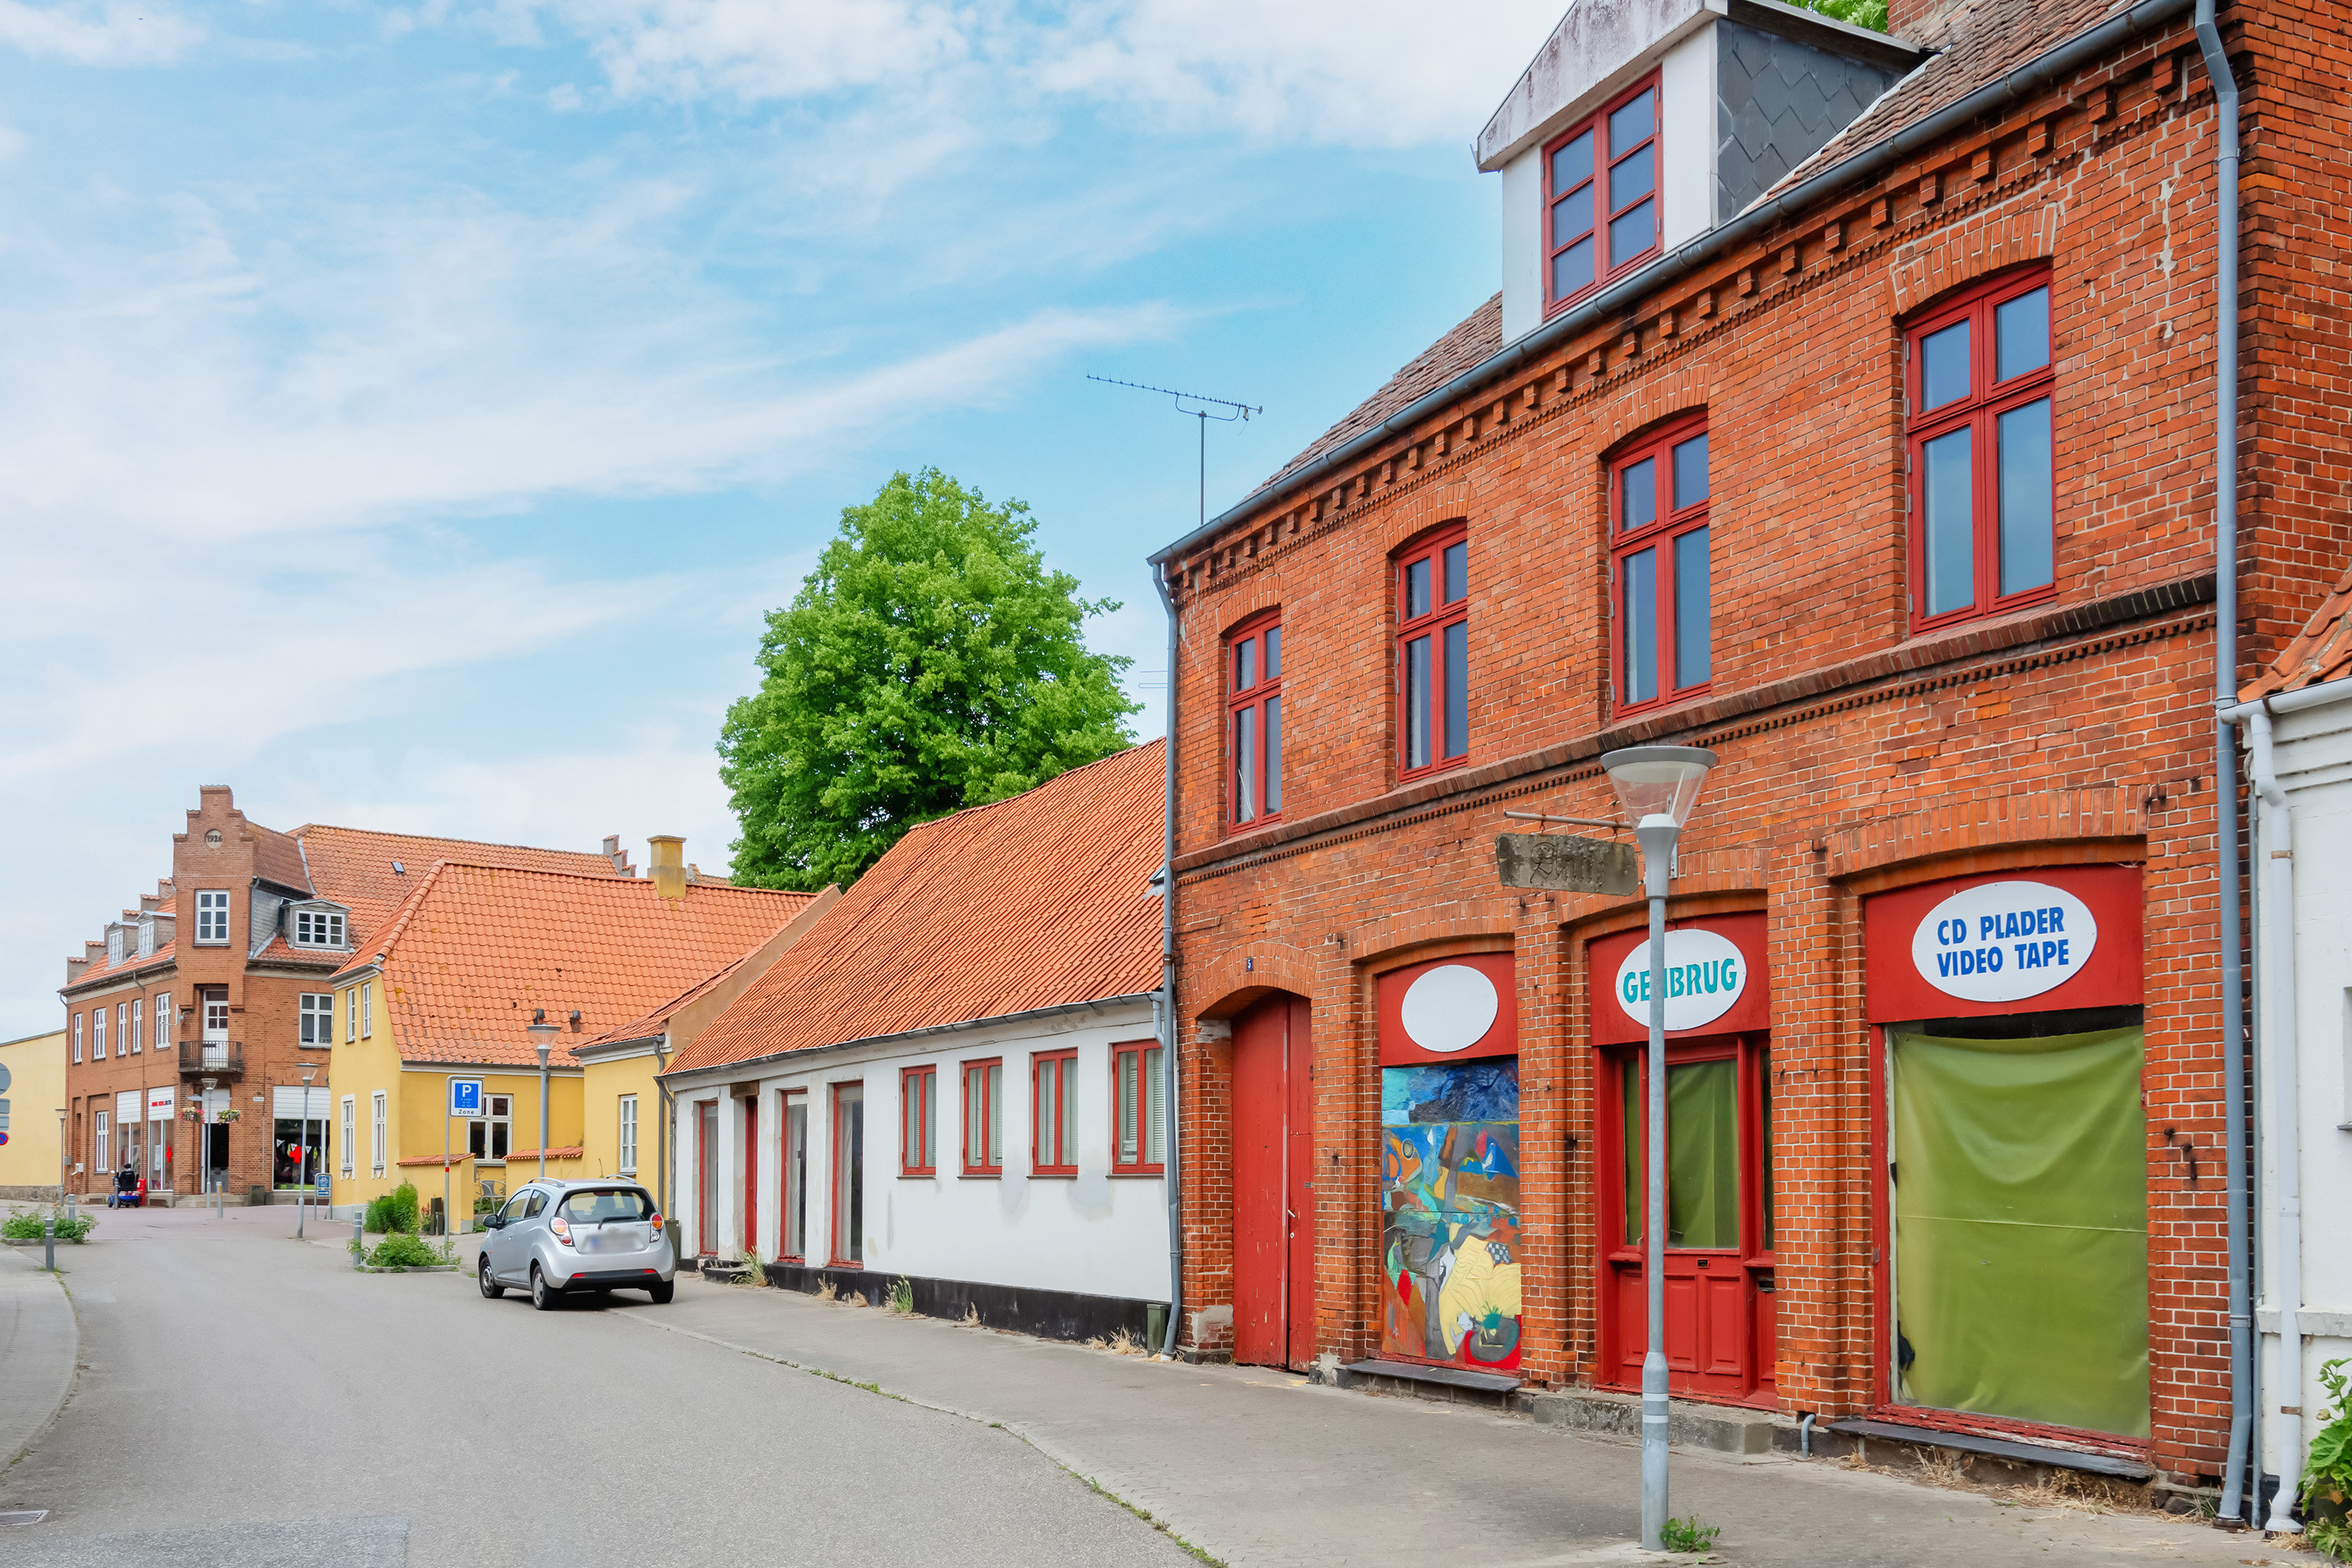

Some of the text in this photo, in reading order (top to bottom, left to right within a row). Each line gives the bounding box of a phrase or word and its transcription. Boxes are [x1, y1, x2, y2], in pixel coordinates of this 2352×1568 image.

[206, 834, 223, 843] 1926
[1937, 906, 2064, 946] CD PLADER
[1936, 938, 2069, 978] VIDEO TAPE
[1623, 958, 1737, 1004] GEBRUG
[462, 1084, 472, 1098] P
